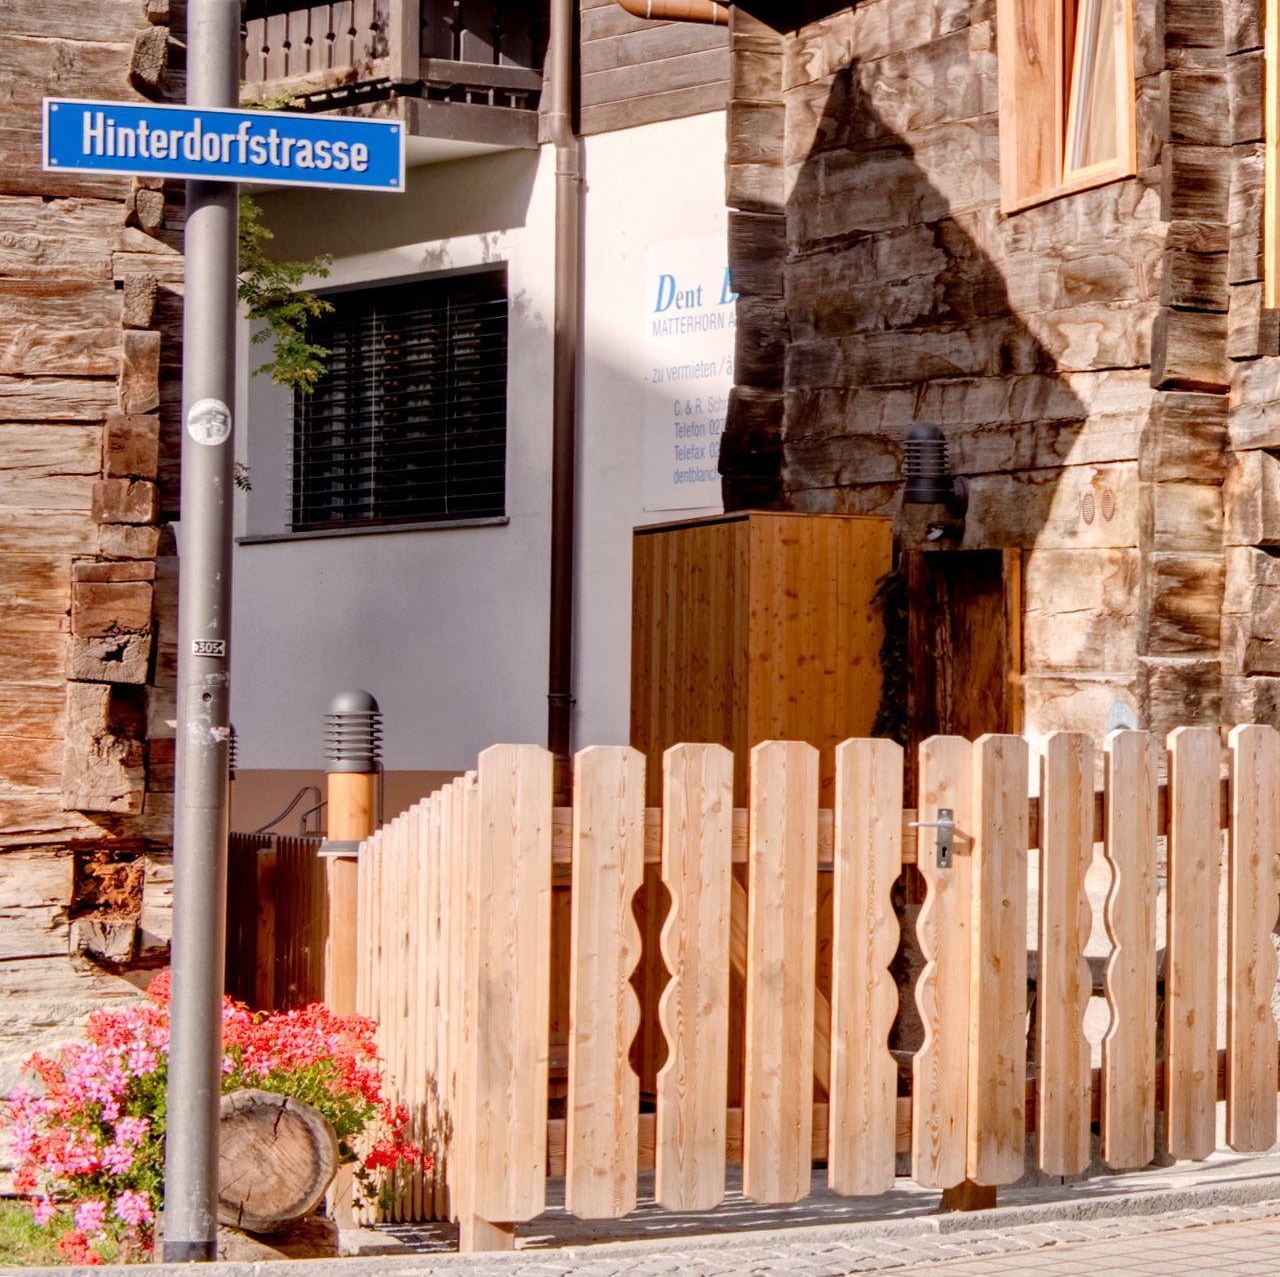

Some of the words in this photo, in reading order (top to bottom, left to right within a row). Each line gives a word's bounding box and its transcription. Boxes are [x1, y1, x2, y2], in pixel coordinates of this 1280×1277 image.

[83, 111, 369, 172] Hinterdorfstrasse
[653, 273, 703, 313] Dent
[652, 313, 725, 338] MATTERHORN
[666, 359, 717, 382] vermieten
[685, 399, 692, 415] &
[674, 421, 705, 438] Telefon
[674, 443, 705, 461] Telefax
